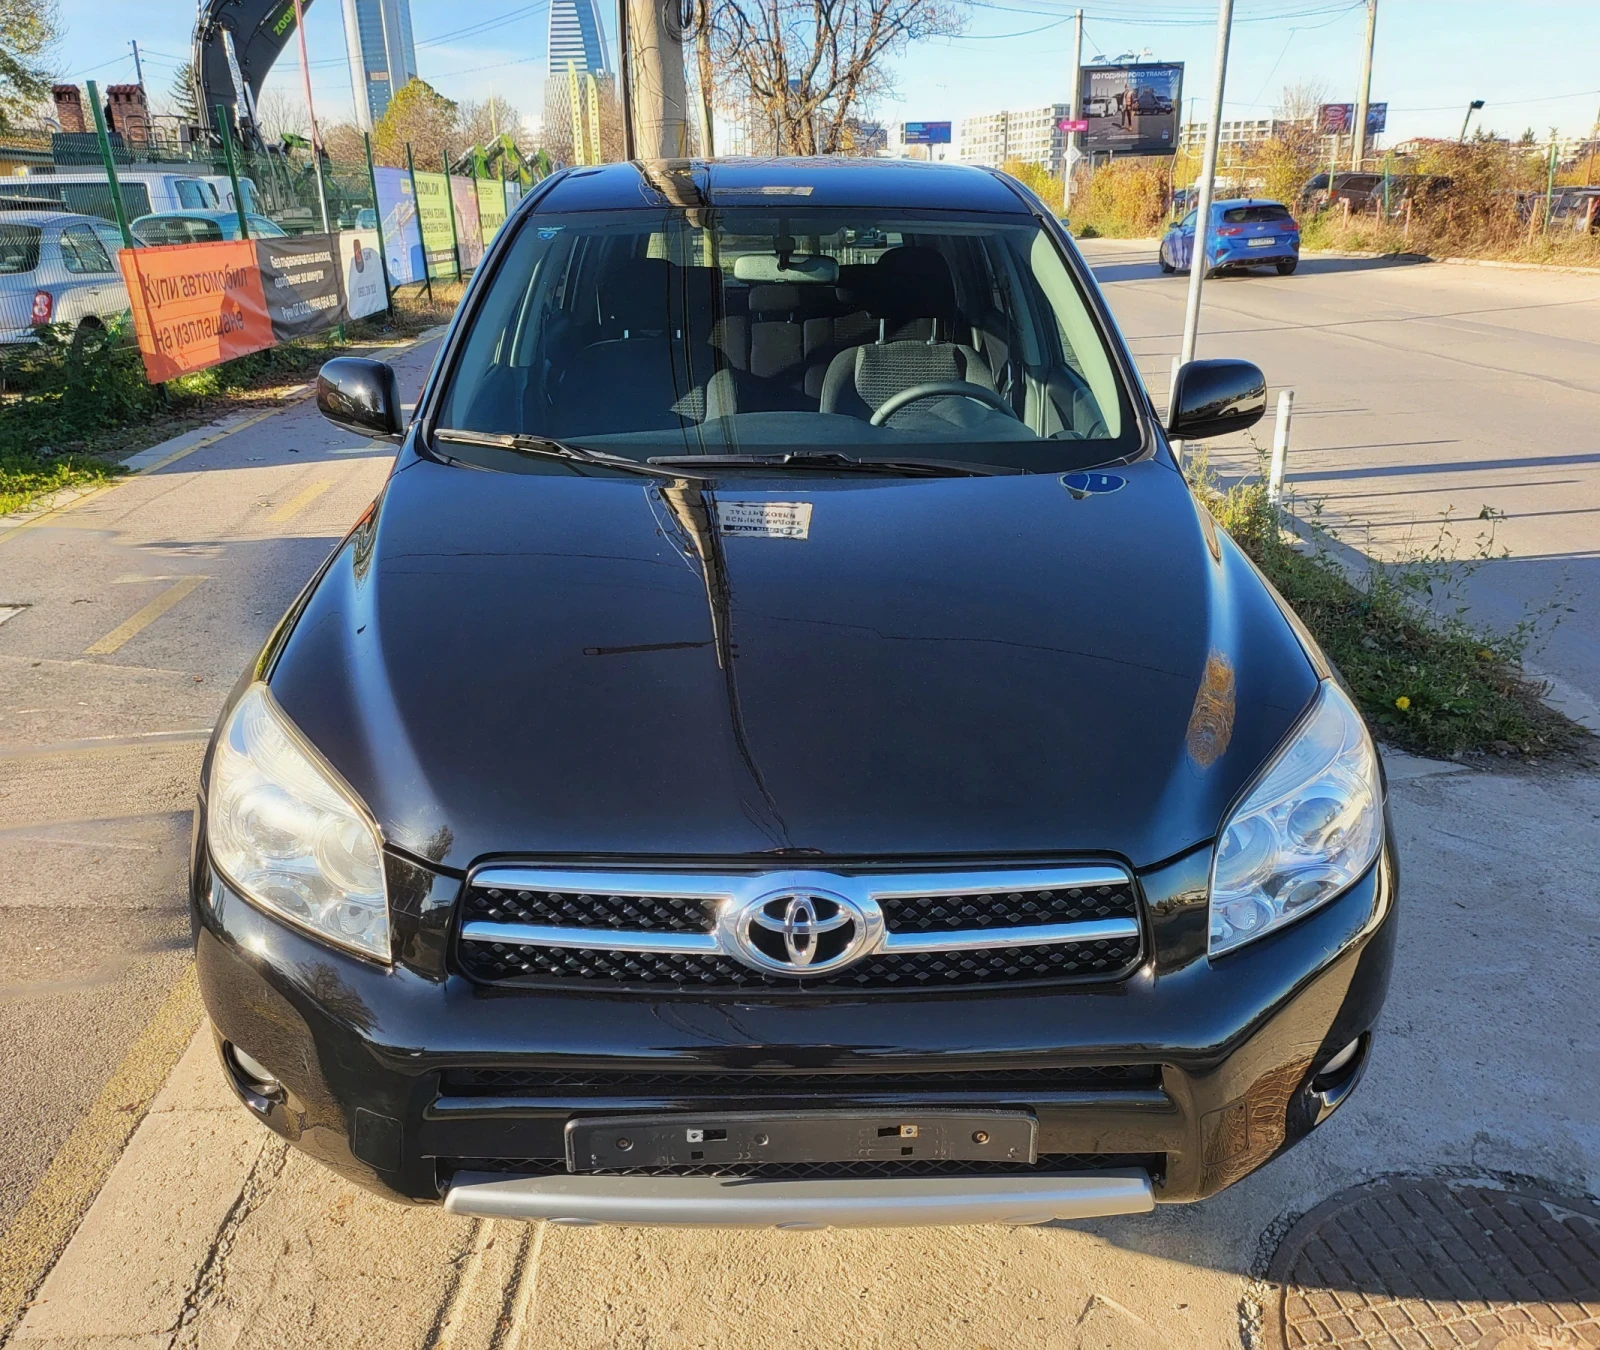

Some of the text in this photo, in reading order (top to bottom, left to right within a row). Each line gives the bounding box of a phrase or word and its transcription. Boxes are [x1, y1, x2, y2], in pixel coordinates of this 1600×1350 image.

[272, 0, 303, 36] ZOOM
[1101, 71, 1128, 79] ГОДИНИ
[143, 263, 248, 309] Купи автомобил
[274, 269, 325, 289] одобрение за минути
[156, 309, 244, 352] на изплащане
